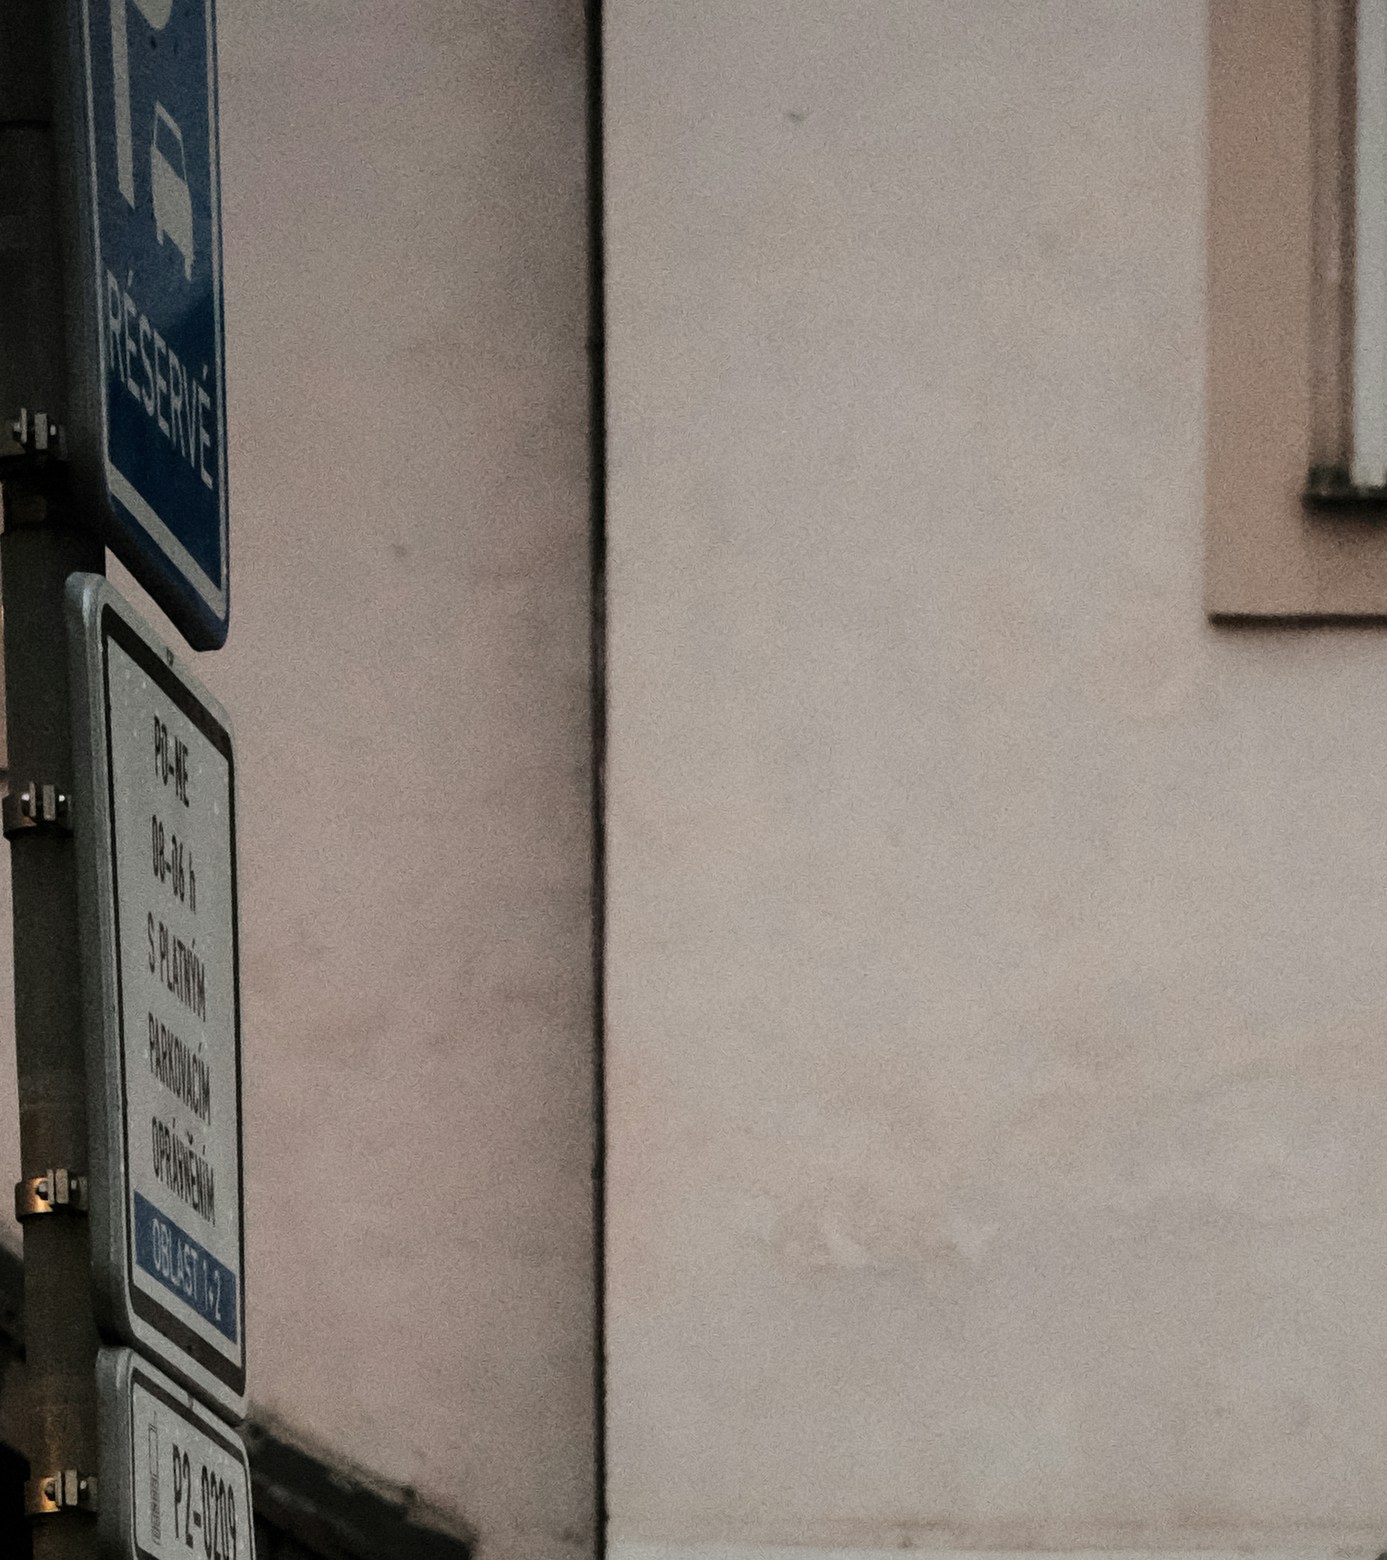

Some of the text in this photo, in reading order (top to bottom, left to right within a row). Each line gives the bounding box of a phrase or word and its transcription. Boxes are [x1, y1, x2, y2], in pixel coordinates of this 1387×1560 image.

[106, 268, 213, 488] RÉSERVÉ
[154, 714, 189, 808] PO-NE
[159, 920, 206, 1023] PLATNÝM
[152, 1217, 198, 1301] OBLAST
